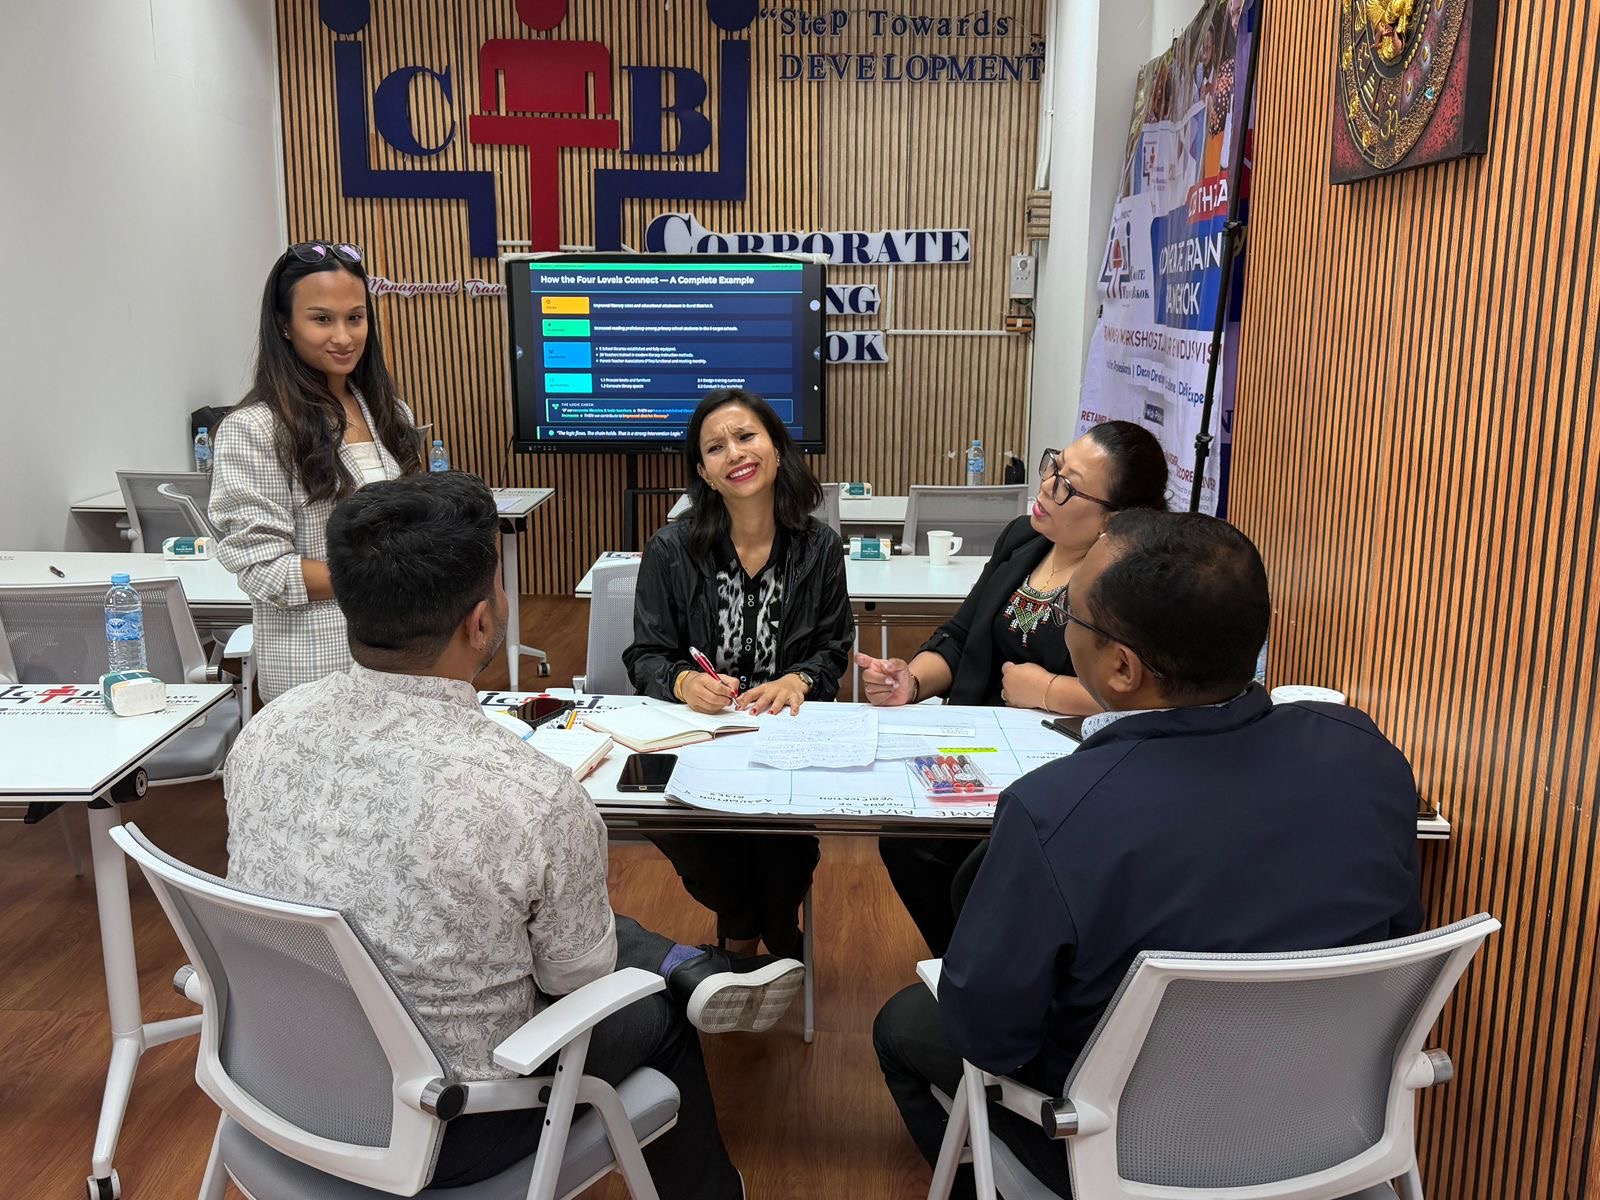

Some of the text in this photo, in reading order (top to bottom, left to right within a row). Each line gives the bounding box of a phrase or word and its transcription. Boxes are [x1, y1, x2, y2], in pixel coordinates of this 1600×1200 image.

[868, 9, 1009, 36] Towards
[645, 214, 970, 264] CORPORATE
[541, 275, 559, 284] How
[560, 275, 575, 284] the
[577, 275, 596, 284] Four
[597, 276, 622, 284] Levels
[624, 276, 659, 284] Connect
[678, 276, 717, 286] Complete
[719, 276, 755, 286] Example
